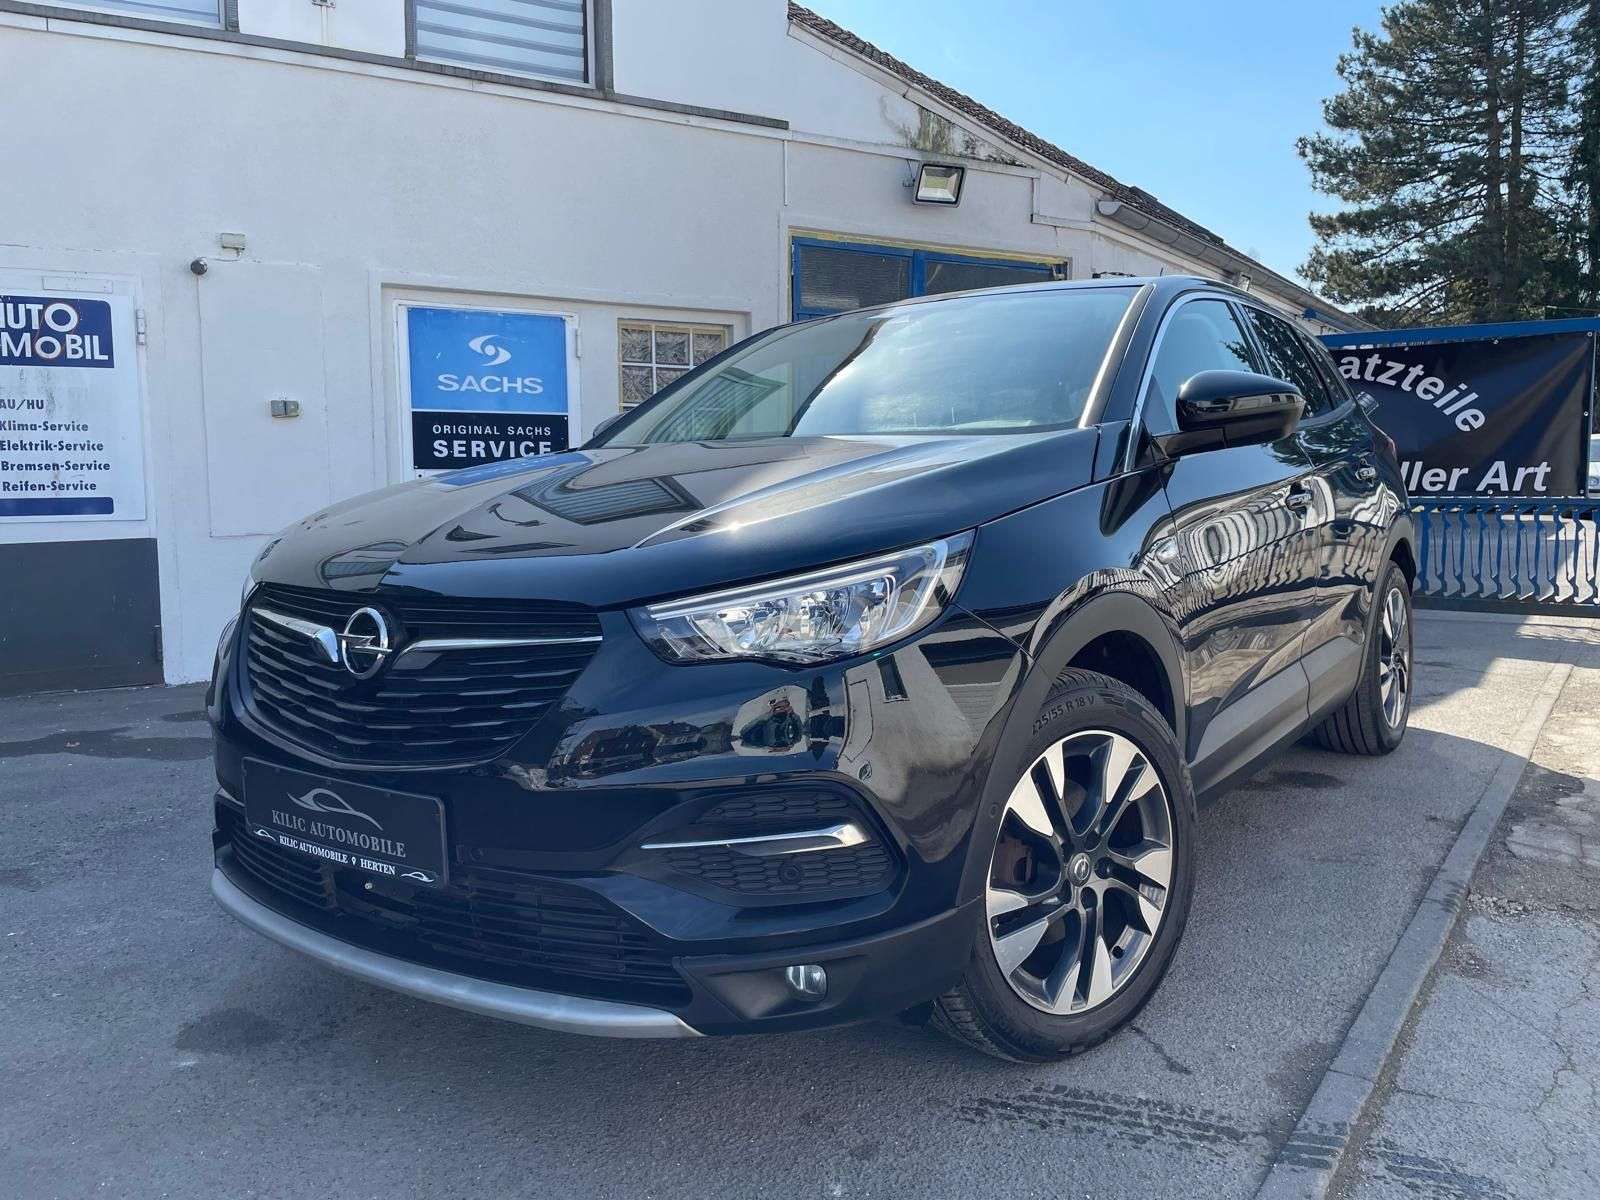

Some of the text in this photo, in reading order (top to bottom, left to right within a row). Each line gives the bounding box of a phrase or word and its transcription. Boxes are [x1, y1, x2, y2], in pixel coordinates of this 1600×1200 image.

[0, 302, 79, 333] UTO
[0, 332, 109, 360] MOBIL
[437, 373, 544, 395] SACHS
[0, 398, 45, 411] AU/HU
[0, 420, 89, 432] Klima-Service
[432, 423, 551, 437] ORIGINAL SACHS
[0, 439, 104, 452] Elektrik-Service
[433, 439, 552, 458] SERVICE
[1, 459, 111, 472] Bremsen-Service
[1476, 460, 1551, 492] Art
[2, 479, 97, 492] Reifen-Service
[1065, 701, 1074, 713] R
[1075, 696, 1085, 708] 18
[271, 809, 407, 858] KILIC AUTOMOBILE
[279, 835, 396, 875] KILIC AUTOMOBILE HERTEN
